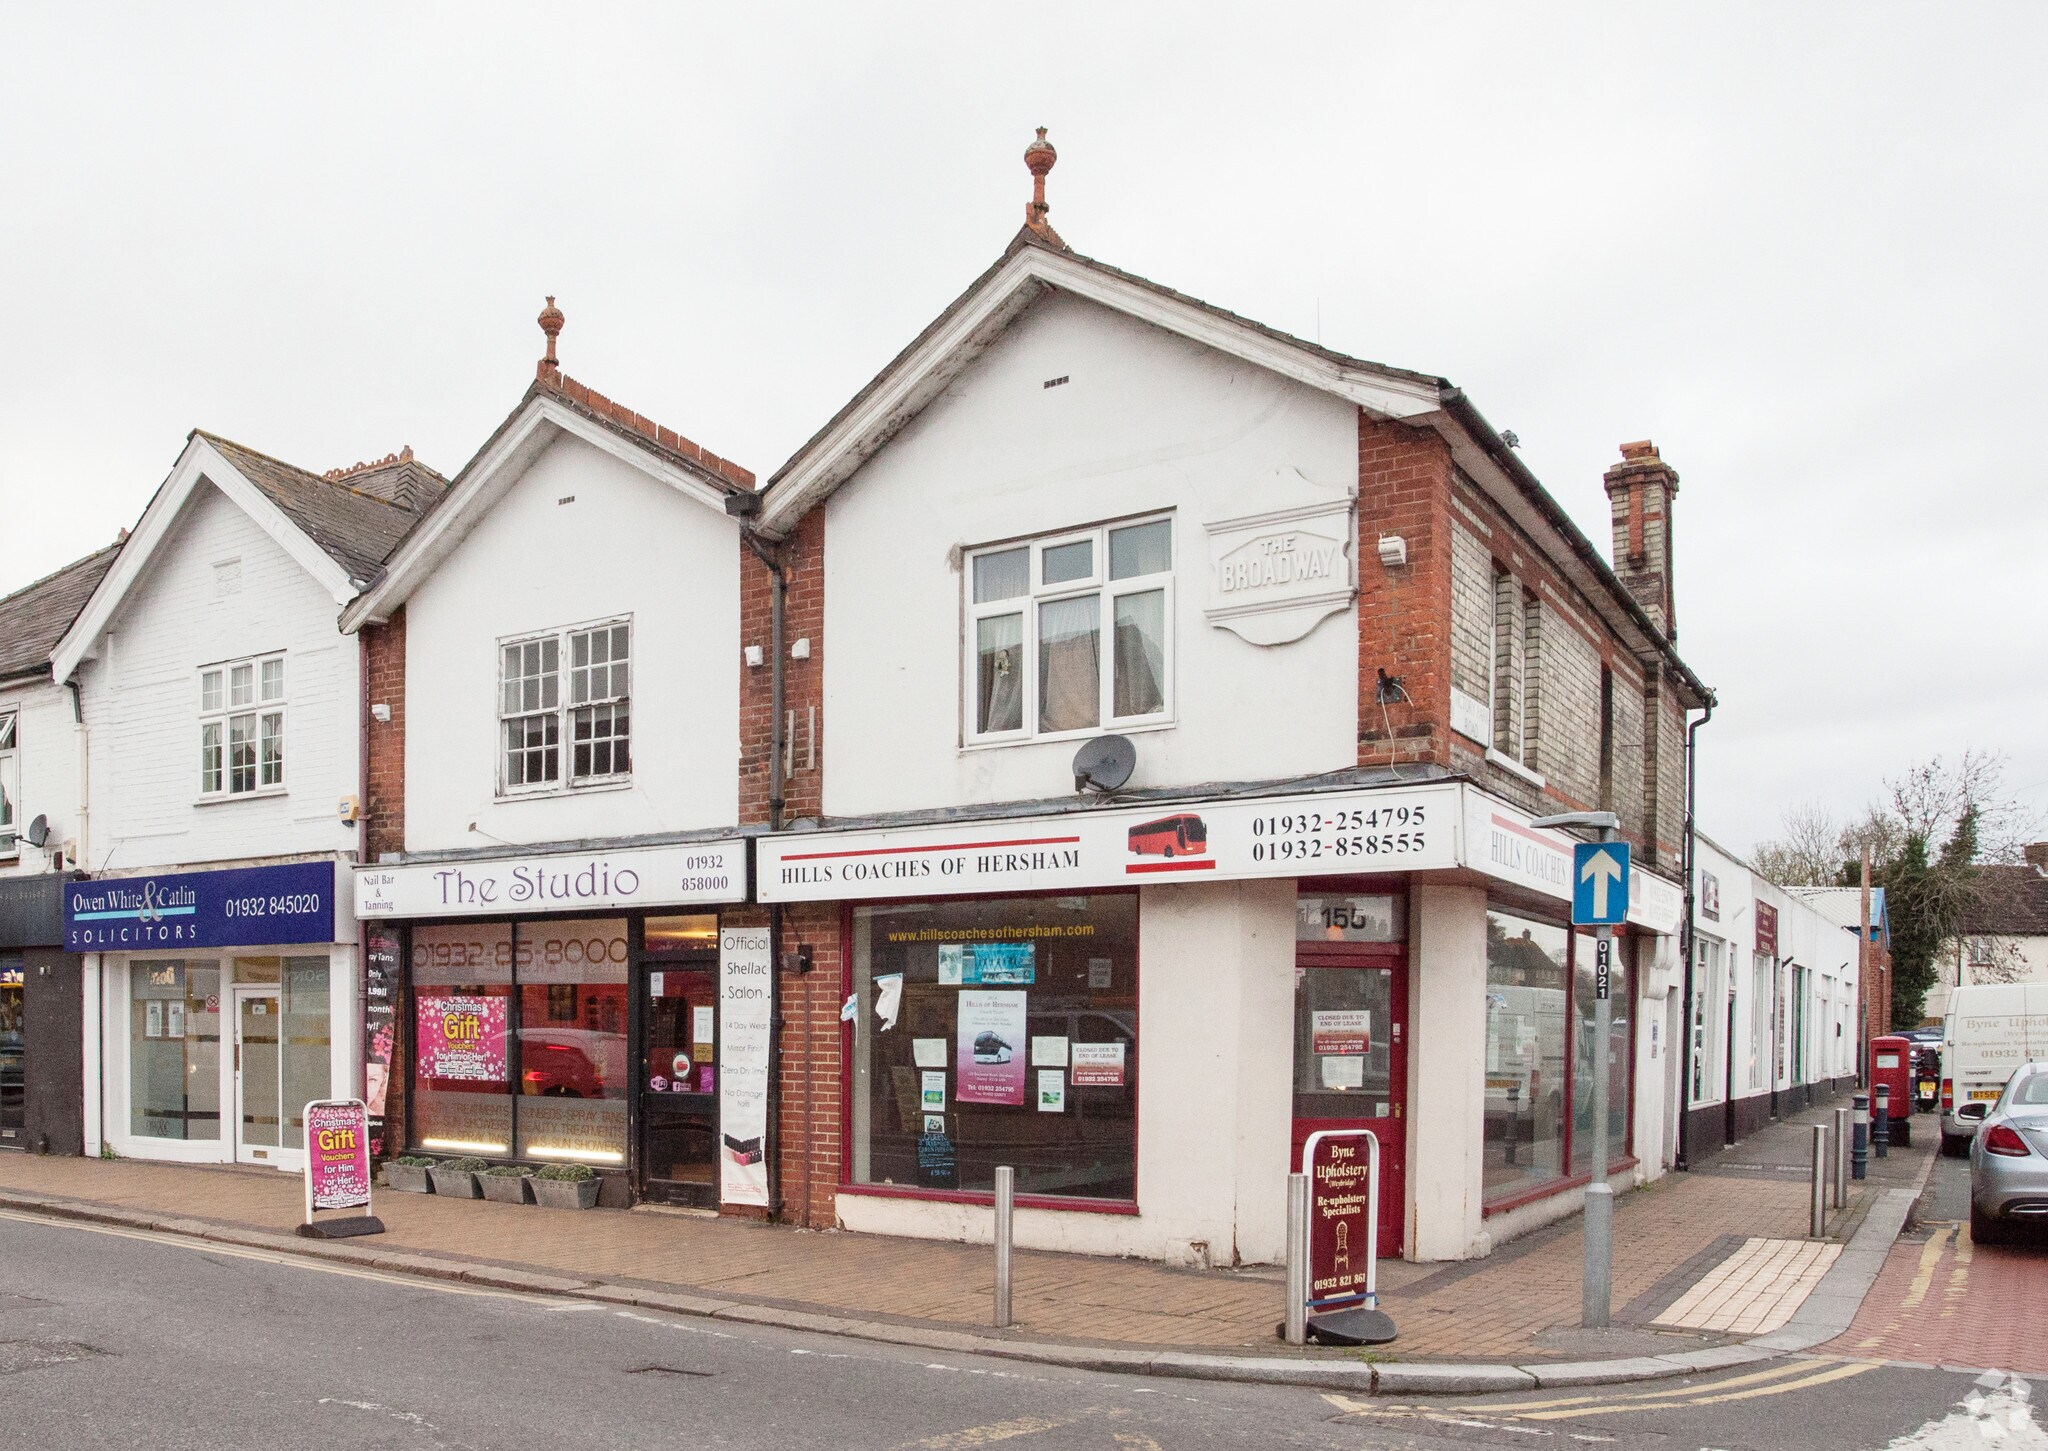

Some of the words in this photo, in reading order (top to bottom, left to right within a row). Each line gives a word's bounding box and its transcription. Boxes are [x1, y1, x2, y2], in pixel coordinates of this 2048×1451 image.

[1261, 536, 1296, 556] THE
[1223, 547, 1336, 593] BROADWAY
[1252, 806, 1426, 837] 01932-254795
[1252, 832, 1426, 862] 01932-858555
[686, 855, 723, 870] 01932
[1491, 829, 1521, 871] HILLS
[1525, 844, 1567, 887] COACHES
[781, 865, 833, 885] HILLS
[842, 860, 930, 881] COACHES
[941, 857, 966, 876] OF
[977, 850, 1080, 873] HERSHAM
[363, 875, 380, 887] Nail
[381, 874, 395, 886] Bar
[433, 867, 499, 907] The
[508, 862, 640, 902] Studio
[681, 876, 729, 892] 858000
[375, 888, 382, 898] &
[73, 892, 105, 912] Owen
[107, 888, 143, 910] White
[138, 880, 163, 923] &
[159, 885, 196, 907] Catlin
[225, 896, 265, 918] 01932
[269, 893, 320, 915] 845020
[364, 899, 394, 913] Tanning
[72, 924, 197, 944] SOLICITORS
[888, 924, 1095, 942] www.hillscoachesofhersham.com
[723, 936, 769, 950] Official
[378, 952, 394, 962] Tans
[727, 961, 767, 975] Shellac
[1598, 941, 1607, 999] 01021
[728, 985, 763, 999] Salon
[440, 1001, 482, 1012] Christmas
[443, 1013, 480, 1040] Gift
[733, 1022, 748, 1031] Day
[749, 1022, 768, 1030] Wear
[1967, 1020, 2000, 1033] Byne
[447, 1041, 476, 1050] Vouchers
[1981, 1049, 2019, 1058] 01932
[2024, 1048, 2046, 1058] 821
[723, 1066, 739, 1075] Zero
[725, 1089, 735, 1097] No
[736, 1089, 763, 1100] Damage
[313, 1117, 357, 1128] Christmas
[318, 1128, 356, 1151] Gift
[320, 1152, 355, 1162] Vouchers
[1331, 1145, 1355, 1164] Byne
[324, 1164, 336, 1174] for
[338, 1163, 355, 1174] Him
[1316, 1164, 1368, 1183] Upholstery
[326, 1178, 336, 1187] or
[337, 1175, 355, 1186] Her!
[1328, 1179, 1357, 1190] (Weybridge)
[1317, 1194, 1366, 1209] Re-upholstery
[1322, 1205, 1361, 1219] Specialists
[1314, 1277, 1337, 1291] 01932
[1339, 1275, 1352, 1287] 821
[1354, 1272, 1366, 1284] 861
